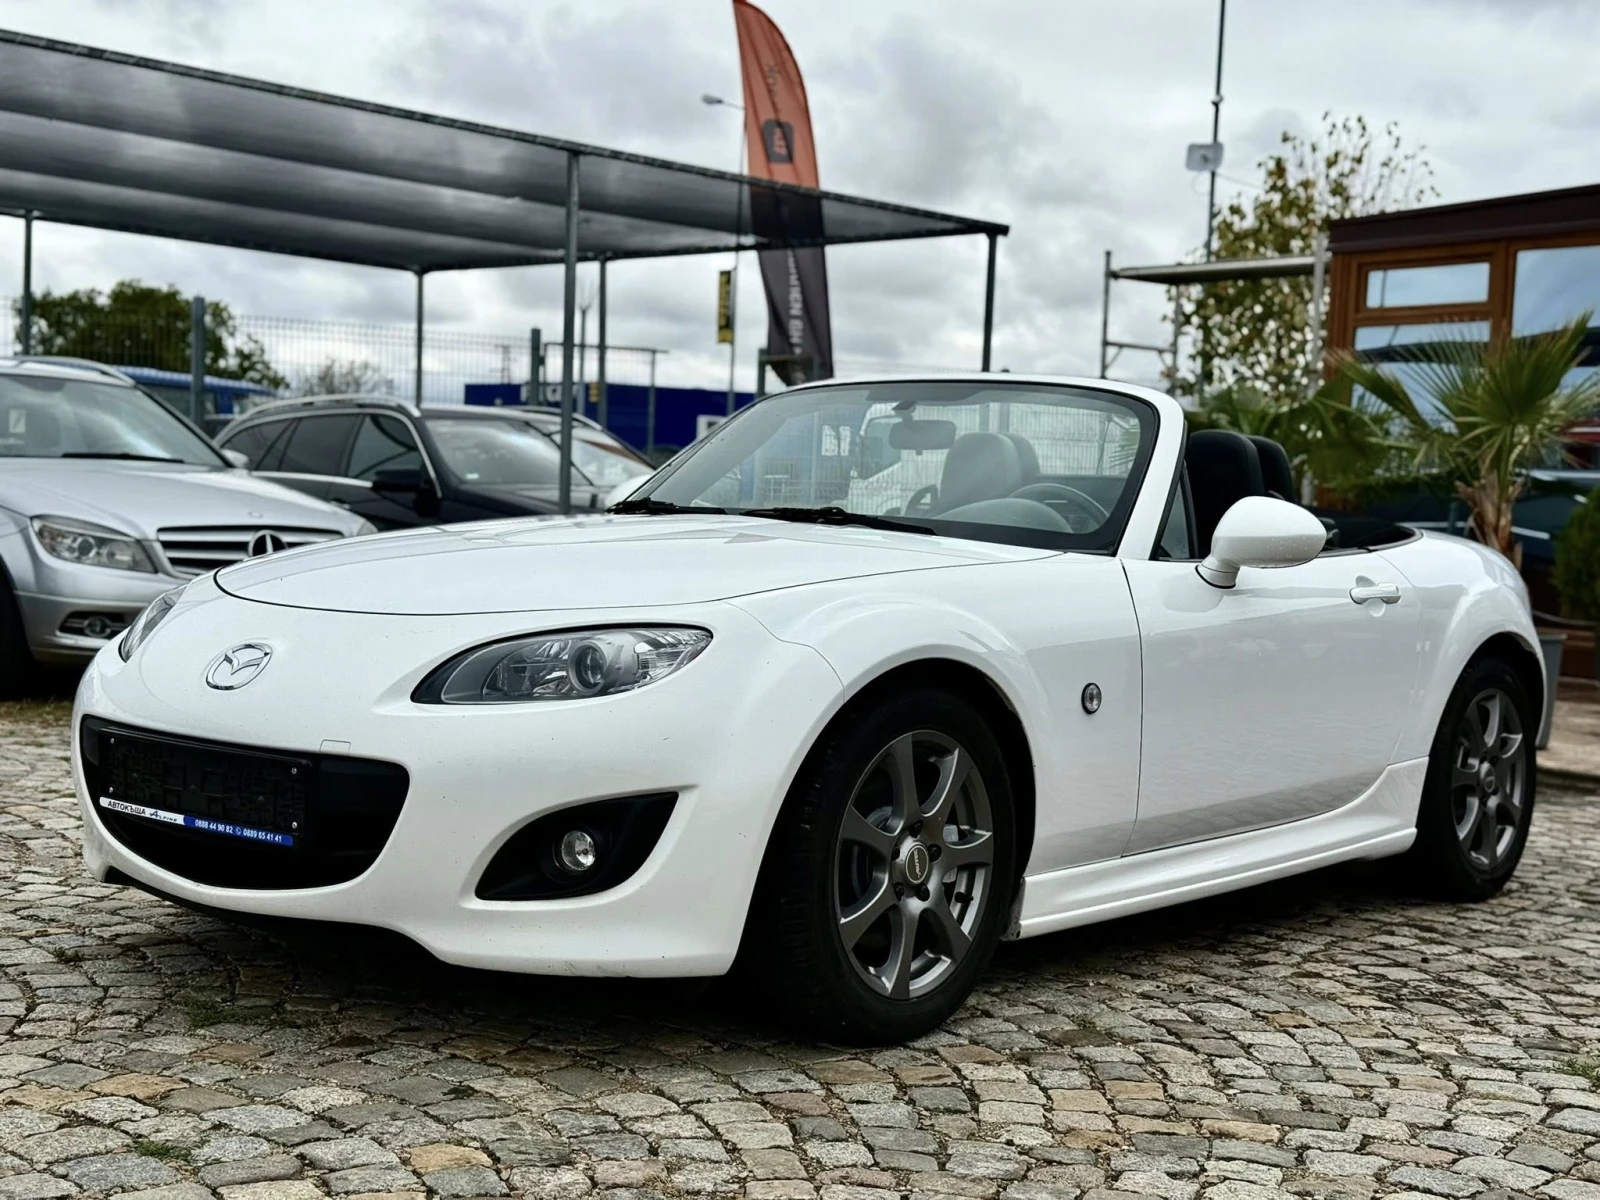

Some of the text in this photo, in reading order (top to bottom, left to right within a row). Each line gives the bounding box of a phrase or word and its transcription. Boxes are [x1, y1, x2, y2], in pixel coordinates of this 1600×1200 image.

[108, 800, 146, 815] АВТОКЪША
[209, 822, 217, 830] 44
[217, 824, 225, 832] 90
[225, 825, 233, 834] 82
[258, 831, 266, 840] 65
[266, 832, 274, 841] 41
[274, 834, 282, 843] 41
